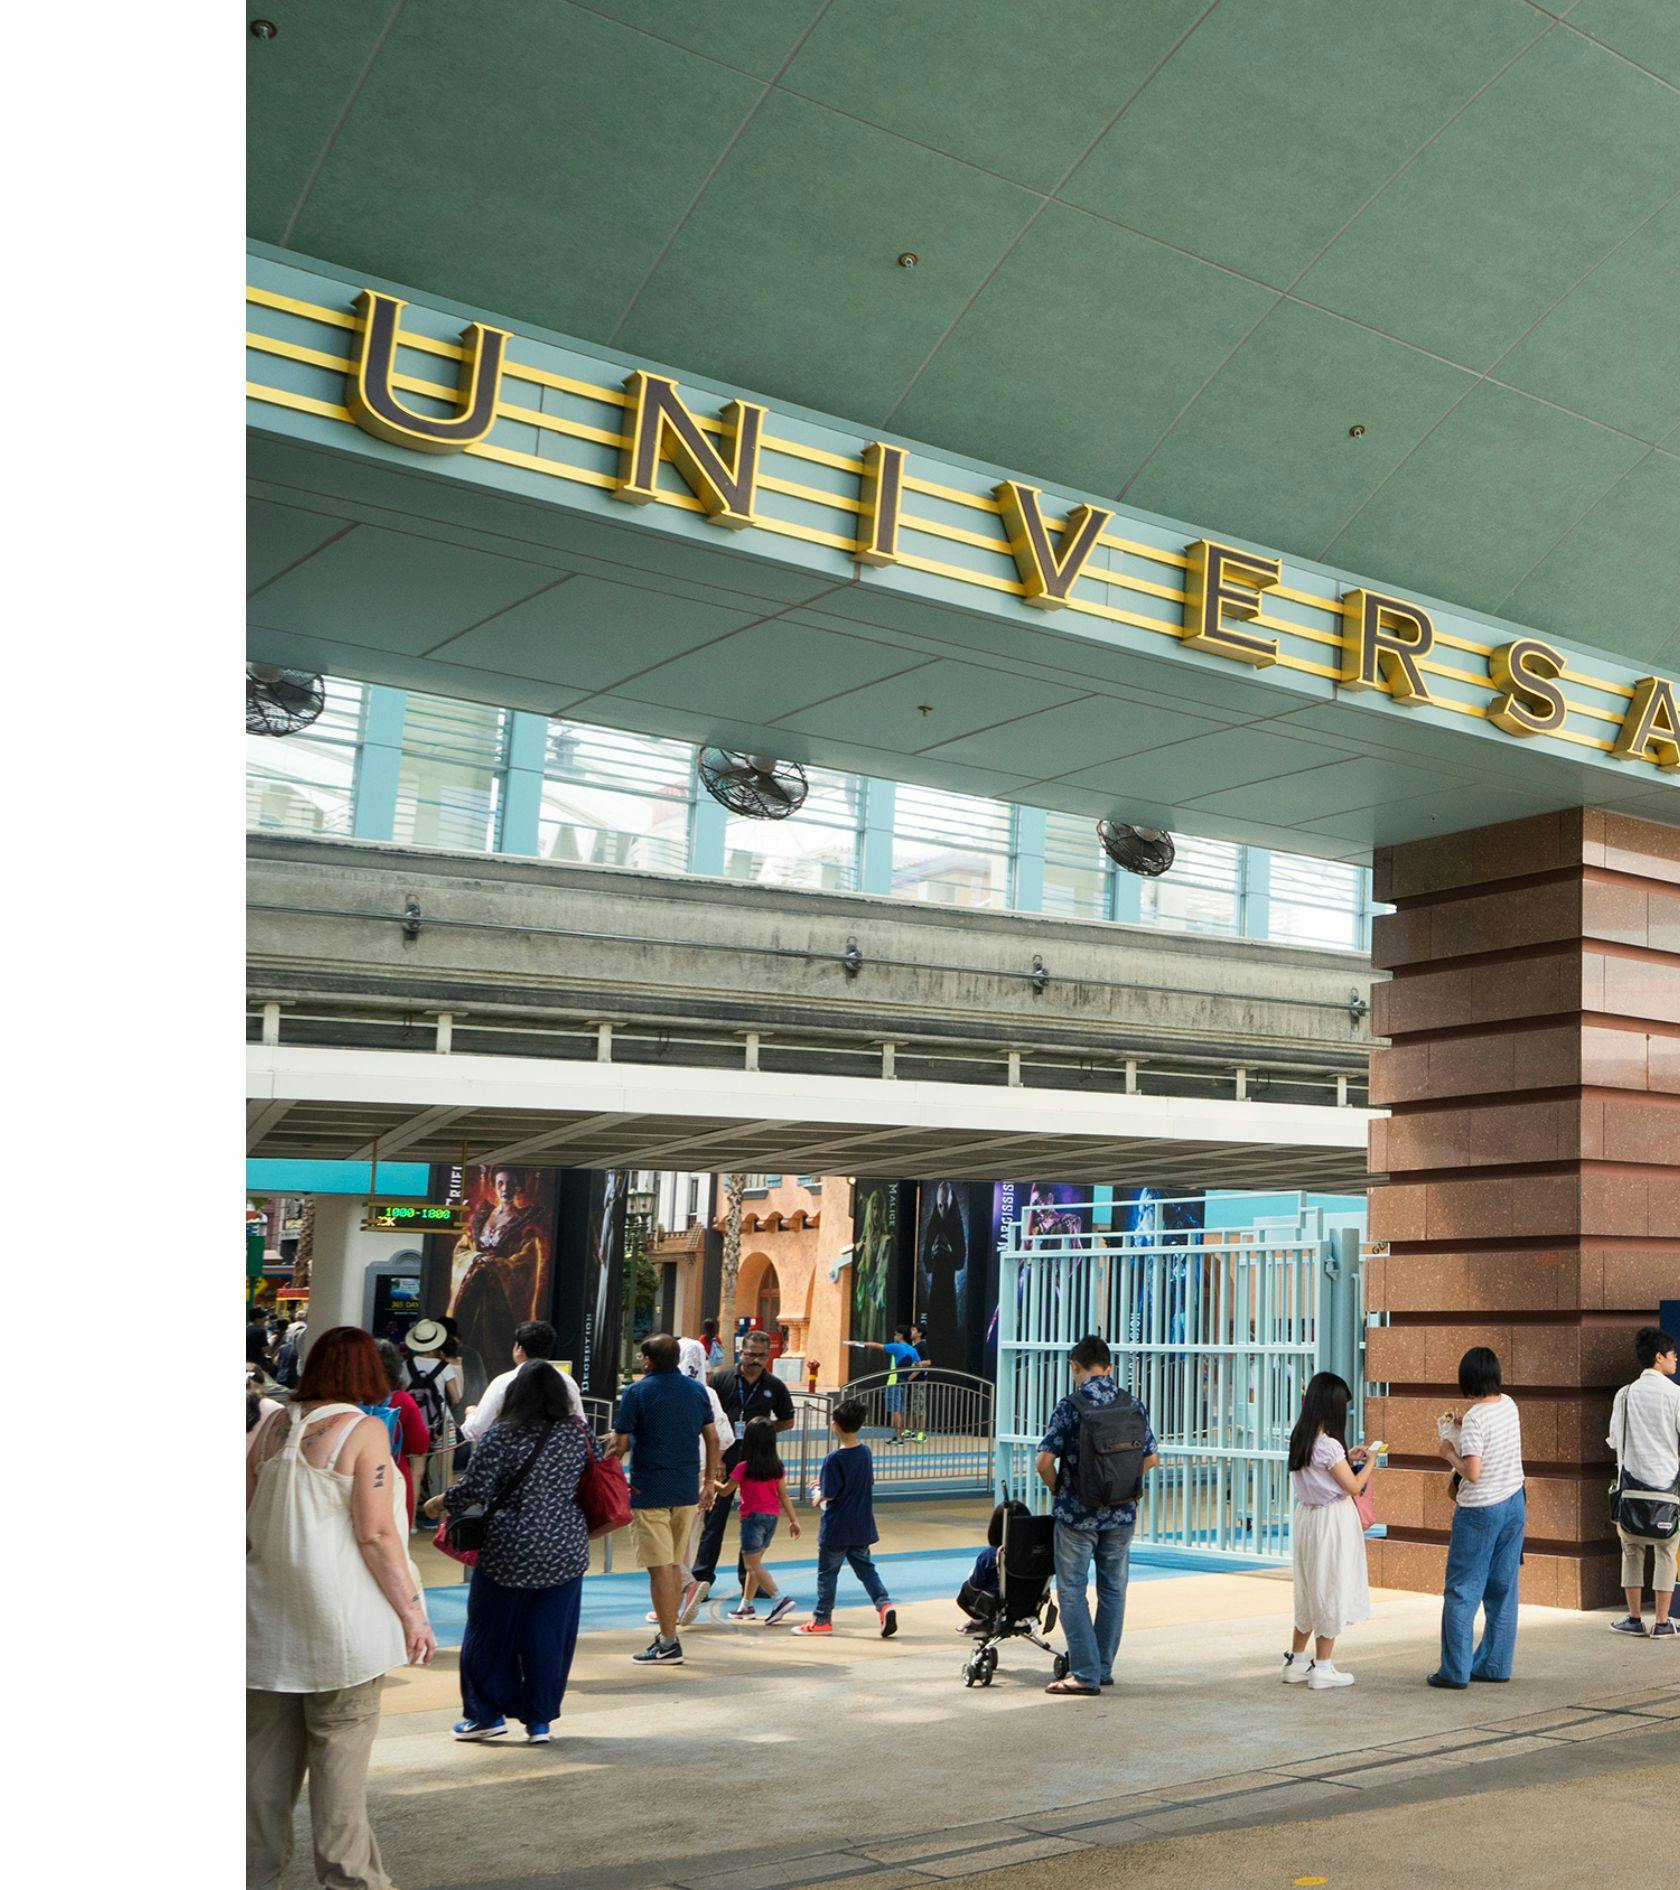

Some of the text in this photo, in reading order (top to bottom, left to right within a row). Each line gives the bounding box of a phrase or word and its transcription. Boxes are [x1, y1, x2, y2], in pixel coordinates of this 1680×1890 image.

[888, 1183, 898, 1227] MALICE
[997, 1182, 1014, 1252] NARCISSIS
[581, 1312, 593, 1393] DECEPTION
